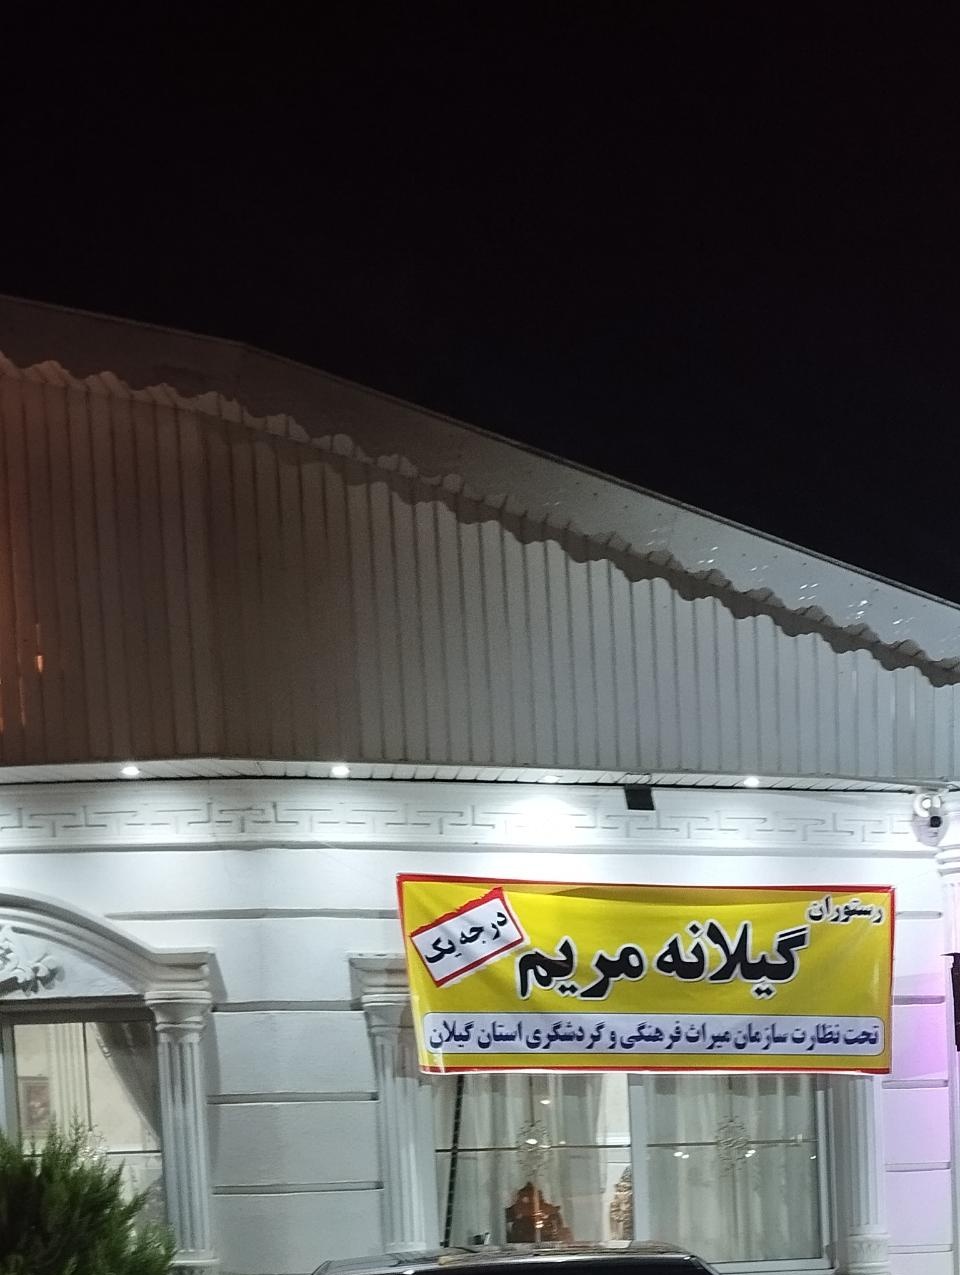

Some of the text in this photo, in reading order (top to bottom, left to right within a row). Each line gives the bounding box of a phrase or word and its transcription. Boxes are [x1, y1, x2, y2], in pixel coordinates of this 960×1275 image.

[809, 897, 882, 922] رستوران
[425, 911, 507, 963] درجه یک
[519, 921, 809, 998] گیلانه مریم
[429, 1020, 879, 1050] تحت نظارت سازمان میراث فرهنگی و گردشگری استان گیلان
